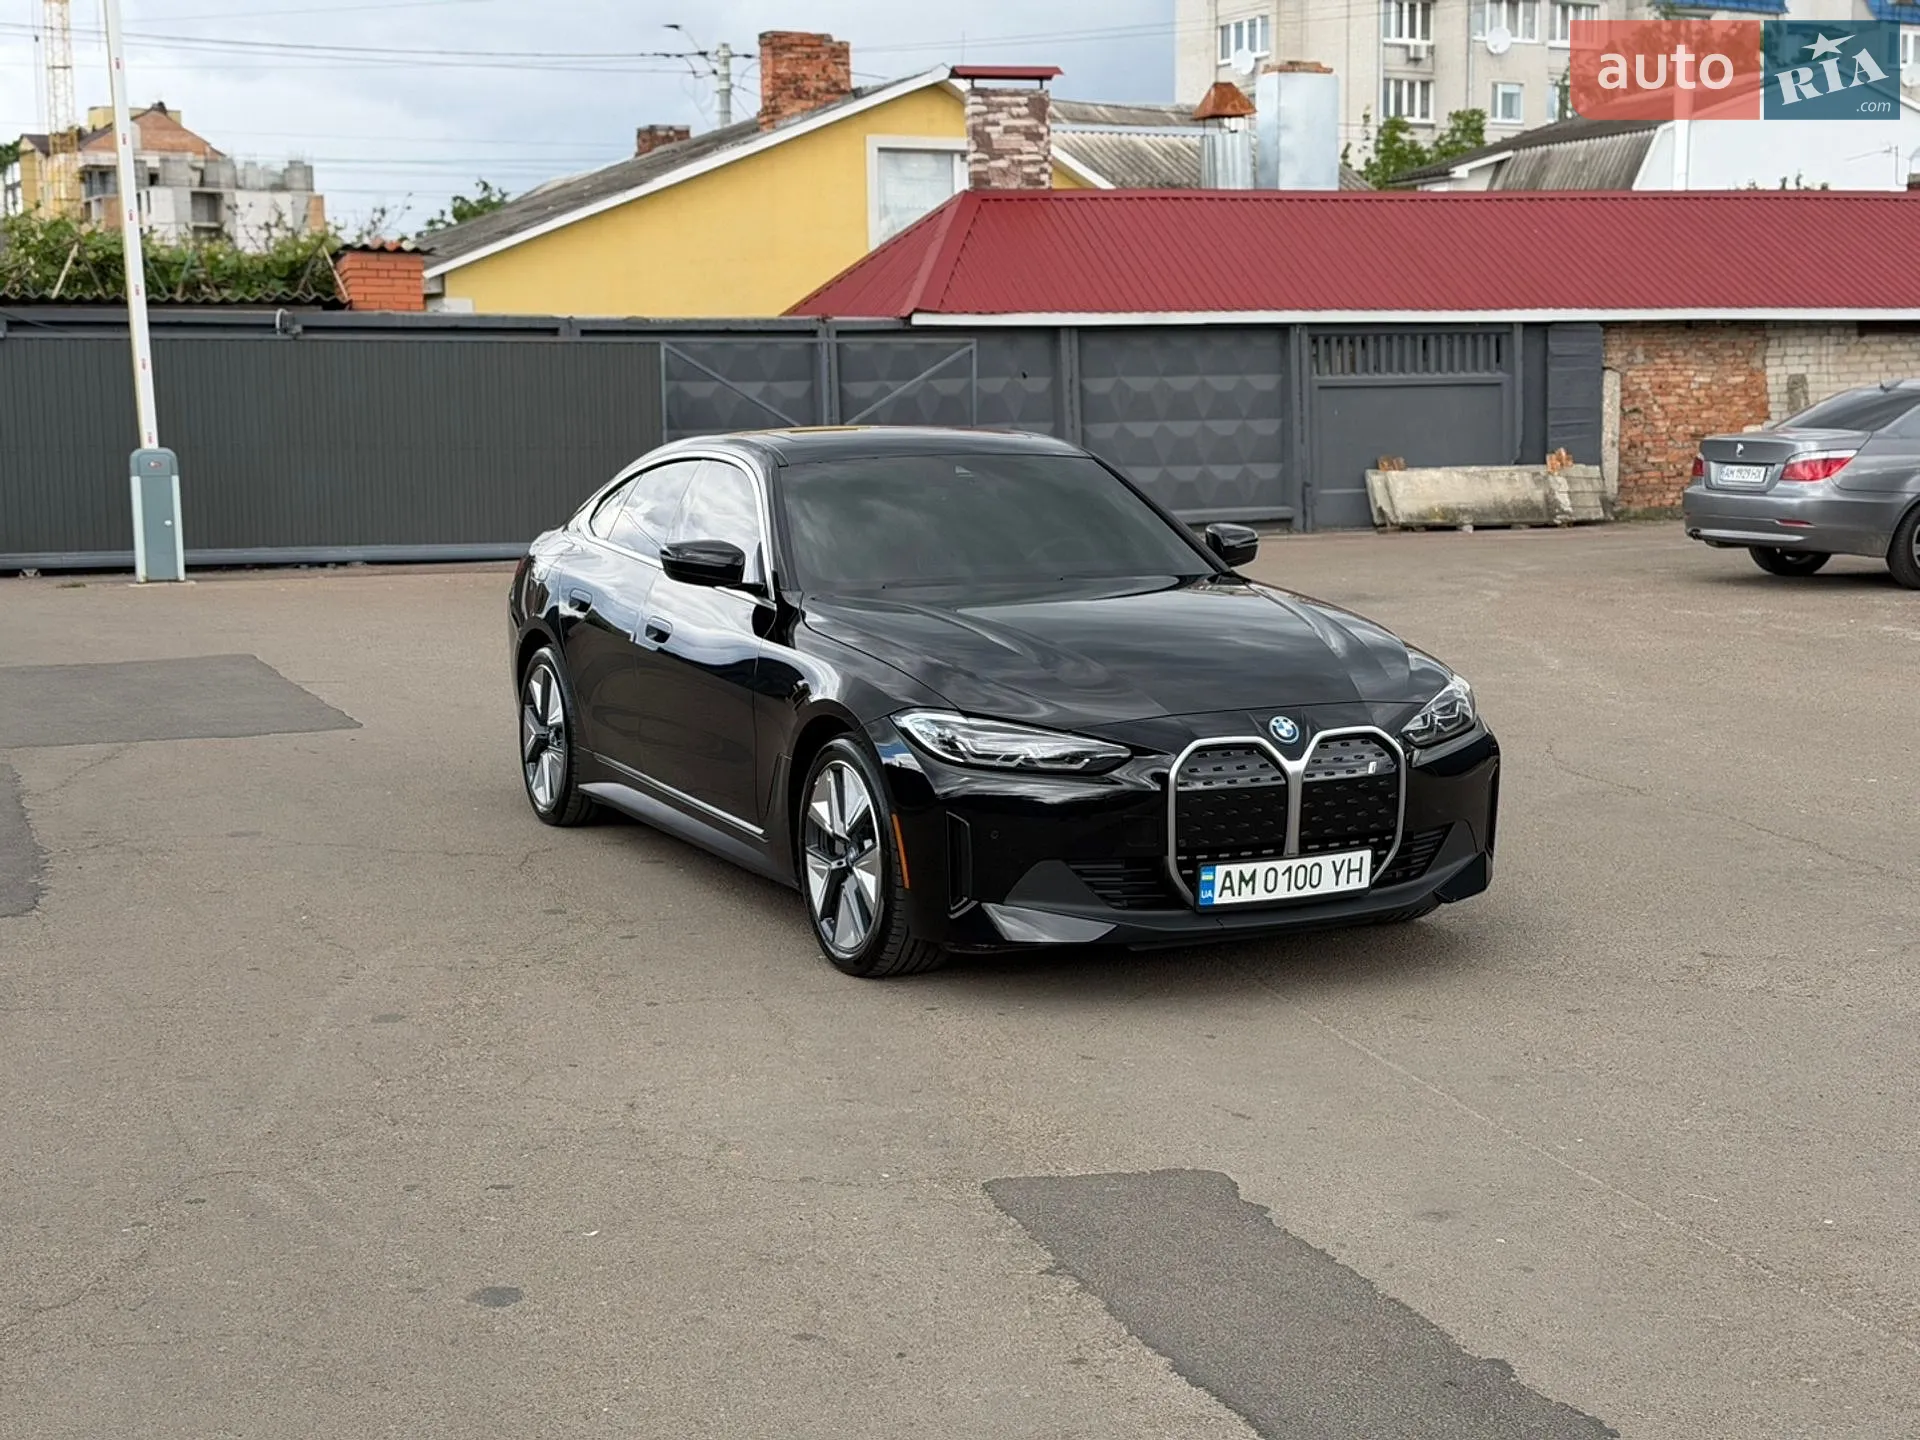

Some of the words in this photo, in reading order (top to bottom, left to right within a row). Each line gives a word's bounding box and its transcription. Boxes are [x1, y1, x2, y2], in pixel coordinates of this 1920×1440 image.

[1218, 868, 1257, 898] AM
[1264, 862, 1323, 894] 0100
[1332, 856, 1364, 887] YH
[1201, 890, 1214, 899] UA
